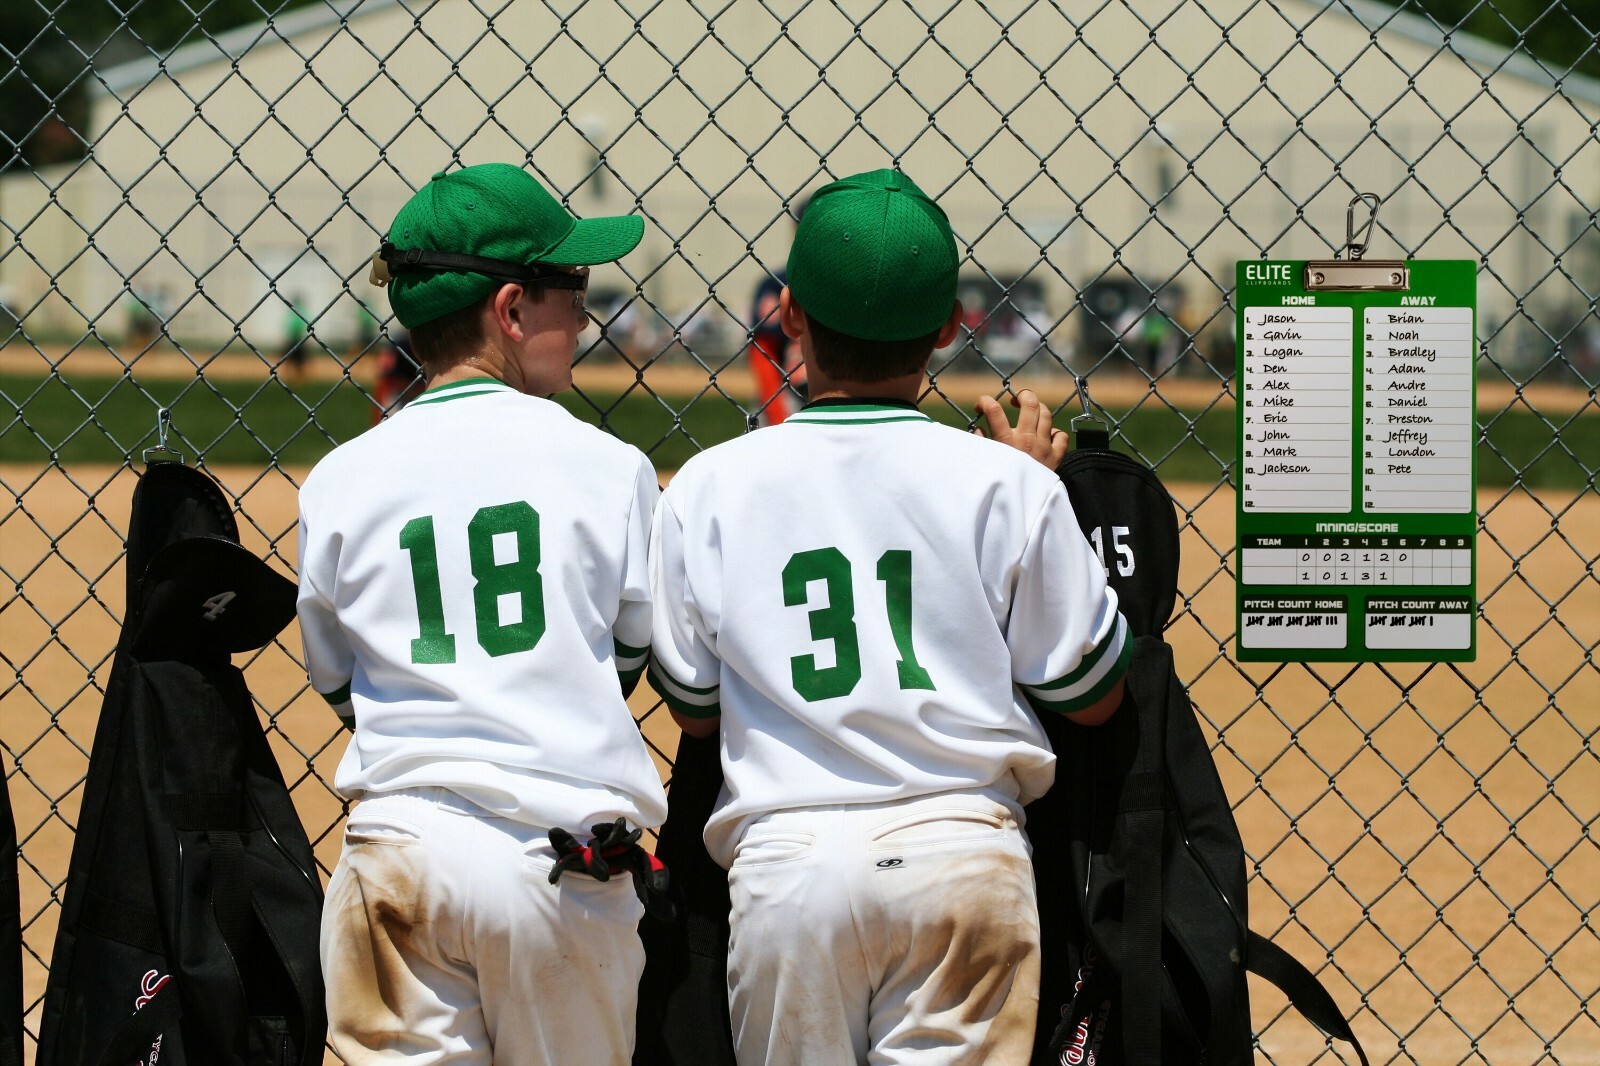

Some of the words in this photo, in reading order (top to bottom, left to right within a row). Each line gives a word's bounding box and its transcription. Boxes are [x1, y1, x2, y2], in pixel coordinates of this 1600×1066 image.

[1246, 265, 1291, 280] ELITE
[1282, 296, 1315, 305] HOME
[1400, 296, 1436, 306] AWAY
[1258, 314, 1296, 326] Jason
[1388, 312, 1424, 323] Brian
[1264, 328, 1301, 341] Gavin
[1389, 330, 1419, 340] Noah
[1264, 347, 1303, 359] Logan
[1388, 347, 1436, 361] Bradley
[1263, 364, 1287, 373] Den
[1388, 363, 1425, 373] Adam
[1263, 380, 1290, 390] Alex
[1388, 380, 1426, 390] Andre
[1263, 395, 1294, 407] Mike
[1388, 395, 1427, 407] Daniel
[1264, 412, 1288, 423] Eric
[1388, 414, 1433, 424] Preston
[1257, 430, 1290, 442] John
[1382, 429, 1428, 445] Jeffrey
[1263, 446, 1297, 457] Mark
[1388, 446, 1435, 457] London
[1258, 463, 1310, 476] Jackson
[1388, 464, 1411, 474] Pete
[1316, 523, 1398, 533] INNING/SCORE
[1090, 526, 1135, 577] 15
[1302, 553, 1310, 561] 0
[1323, 553, 1331, 561] 0
[1340, 553, 1350, 561] 2
[1363, 553, 1371, 561] 1
[1380, 553, 1390, 561] 2
[1399, 553, 1407, 561] 0
[1302, 572, 1309, 580] 1
[1322, 572, 1331, 580] 0
[1340, 572, 1348, 580] 1
[1361, 572, 1370, 580] 3
[1380, 572, 1387, 580] 1
[399, 500, 546, 664] 18
[202, 591, 236, 620] 4
[1244, 600, 1274, 608] PITCH
[1277, 600, 1311, 608] COUNT
[1315, 600, 1343, 608] HOME
[1368, 601, 1398, 609] PITCH
[1401, 601, 1435, 609] COUNT
[1439, 601, 1469, 609] AWAY
[782, 546, 937, 702] 31
